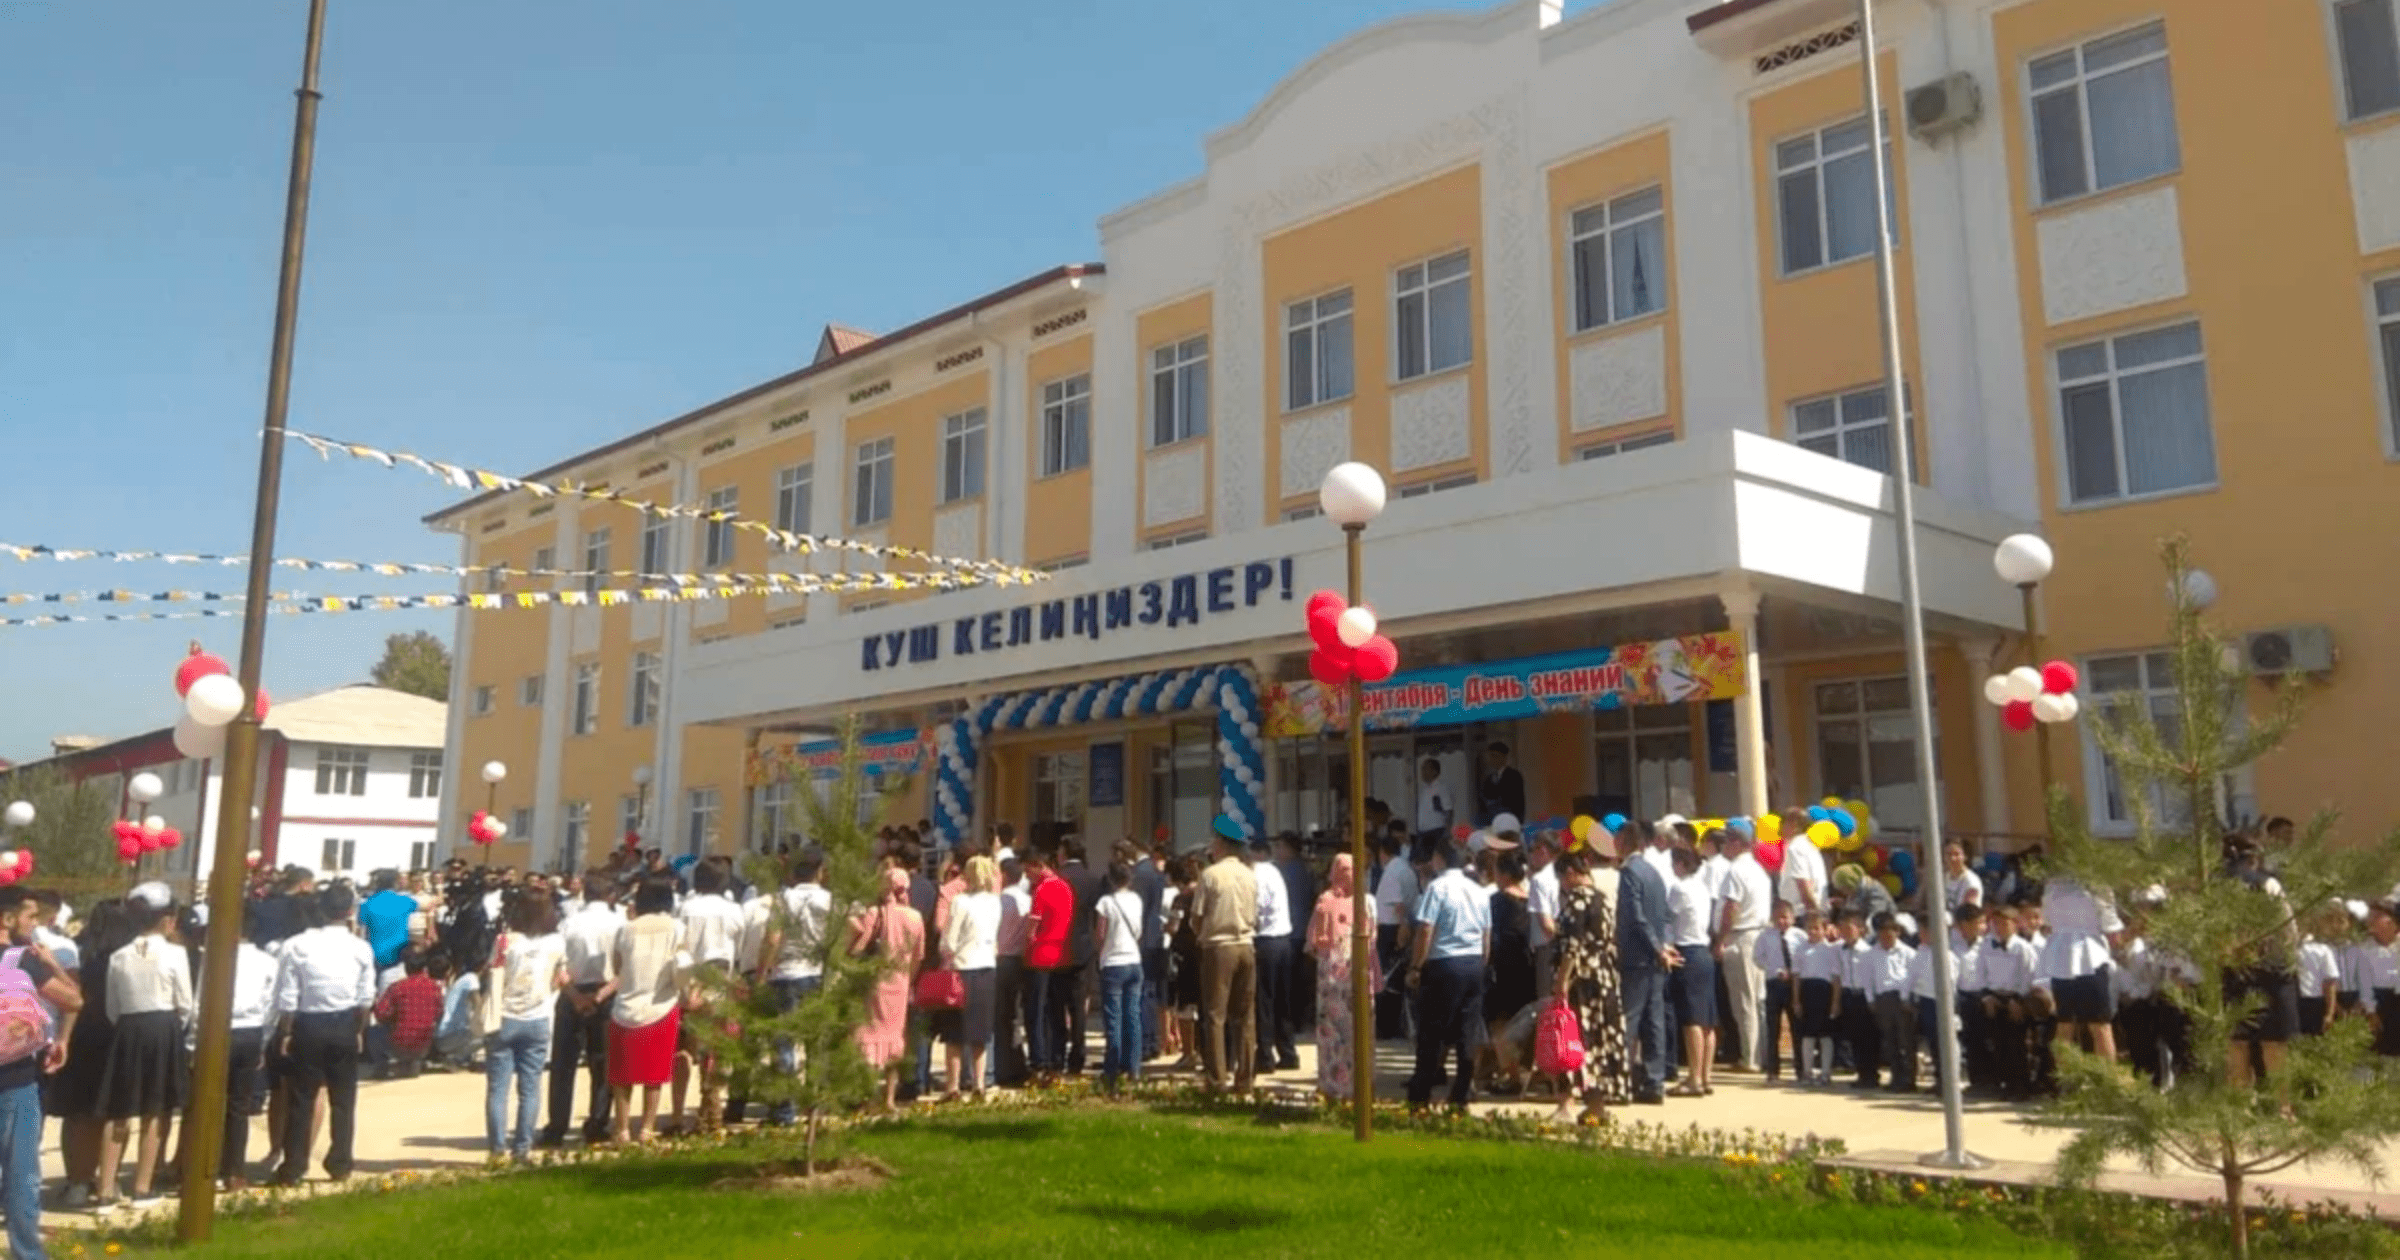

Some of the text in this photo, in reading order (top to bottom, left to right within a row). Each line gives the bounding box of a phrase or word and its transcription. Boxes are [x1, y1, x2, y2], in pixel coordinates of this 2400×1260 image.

[861, 557, 1294, 671] КУШ КЕЛИҢИЗДЕР!
[1361, 684, 1447, 715] ентября
[1465, 675, 1525, 707] День
